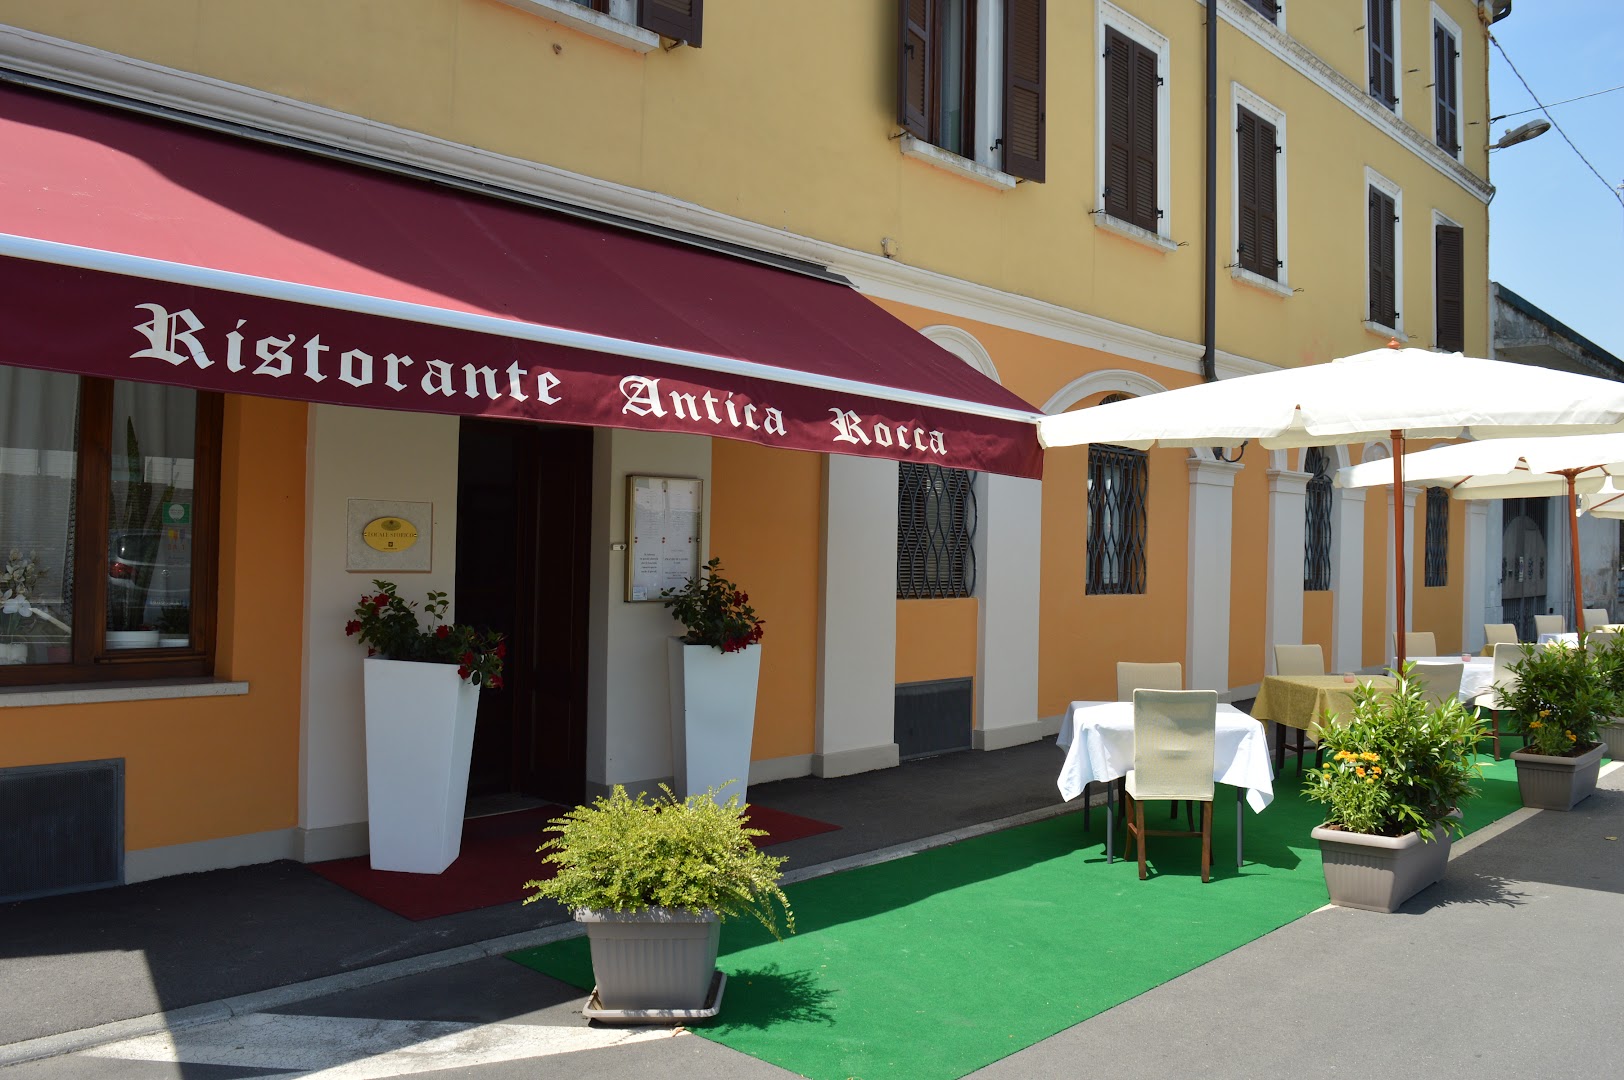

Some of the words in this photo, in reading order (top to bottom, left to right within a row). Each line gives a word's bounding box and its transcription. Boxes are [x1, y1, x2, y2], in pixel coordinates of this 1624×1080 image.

[130, 303, 563, 406] Ristorante
[618, 375, 788, 437] Antica
[829, 407, 948, 456] Rocca
